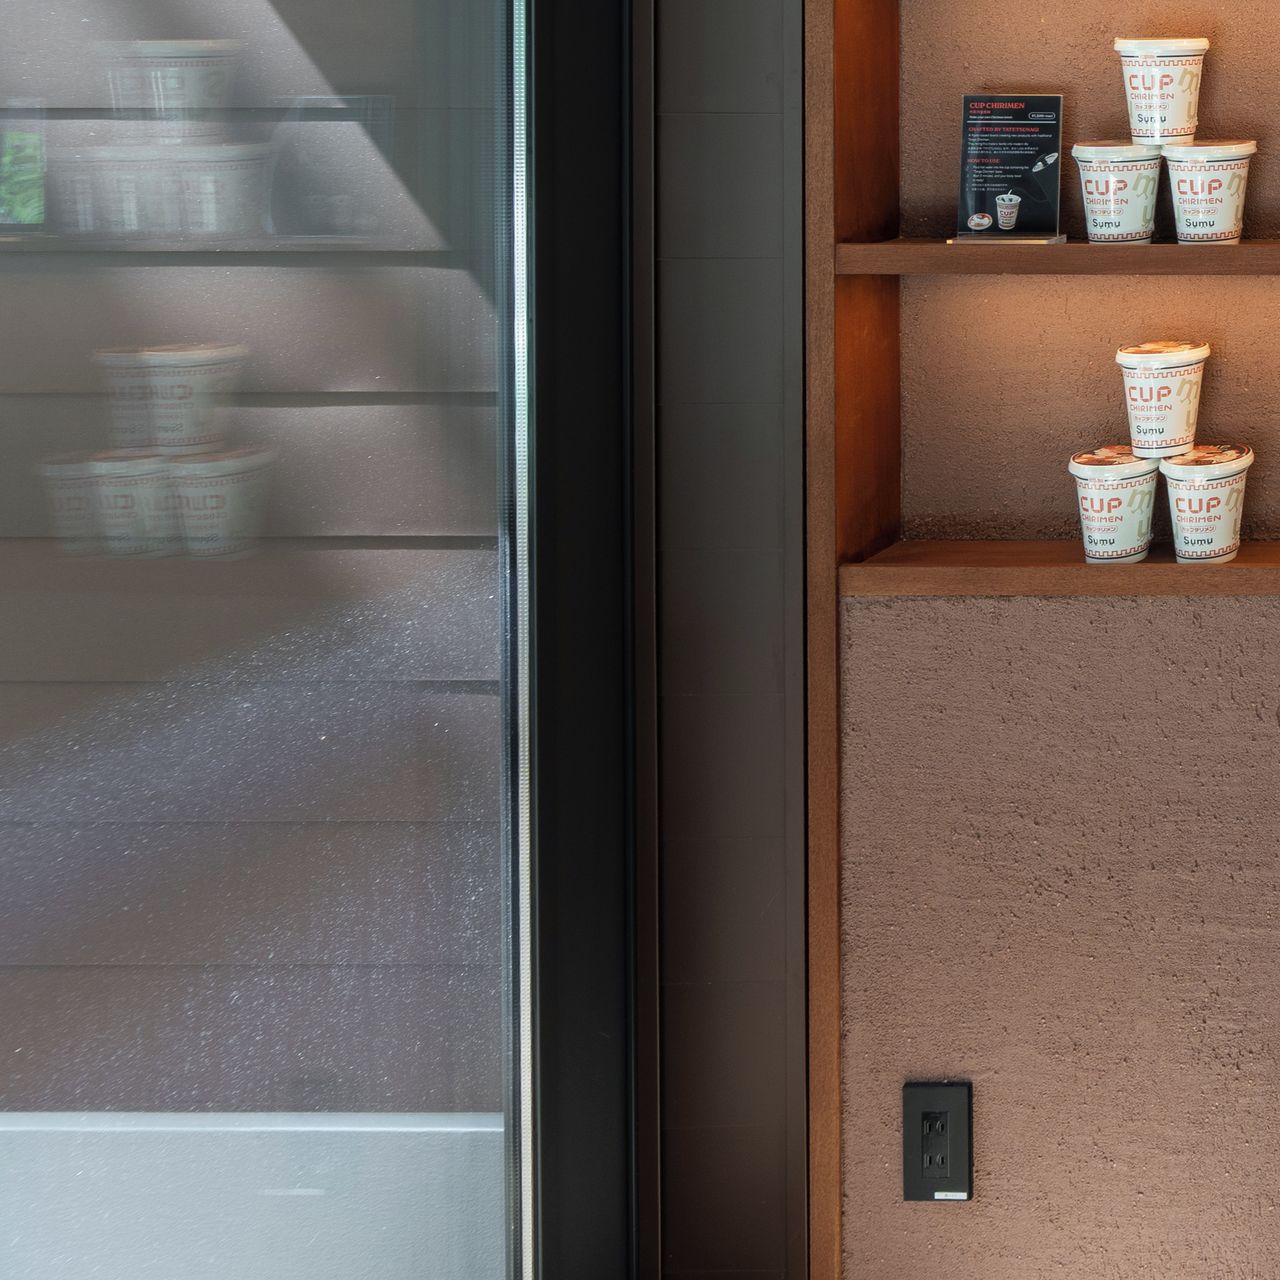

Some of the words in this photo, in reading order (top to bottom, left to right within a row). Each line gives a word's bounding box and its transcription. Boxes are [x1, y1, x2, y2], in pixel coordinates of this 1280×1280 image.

[1128, 74, 1175, 91] CUP
[969, 102, 986, 110] CUP
[986, 102, 1025, 110] CHIRIMEN
[1084, 178, 1128, 195] CUP
[1177, 178, 1223, 195] CUP
[1086, 197, 1129, 205] CHIRIMEN
[1178, 197, 1223, 205] CHIRIMEN
[1092, 218, 1121, 228] Sumu
[1185, 218, 1215, 228] Sumu
[1128, 385, 1172, 403] CUP
[1129, 404, 1173, 412] CHIRIMEN
[1136, 424, 1165, 435] Sumu
[1079, 496, 1123, 514] CUP
[1175, 496, 1222, 514] CUP
[1081, 515, 1124, 523] CHIRIMEN
[1176, 514, 1222, 523] CHIRIMEN
[1087, 534, 1115, 546] Sumu
[1183, 534, 1214, 546] Sumu
